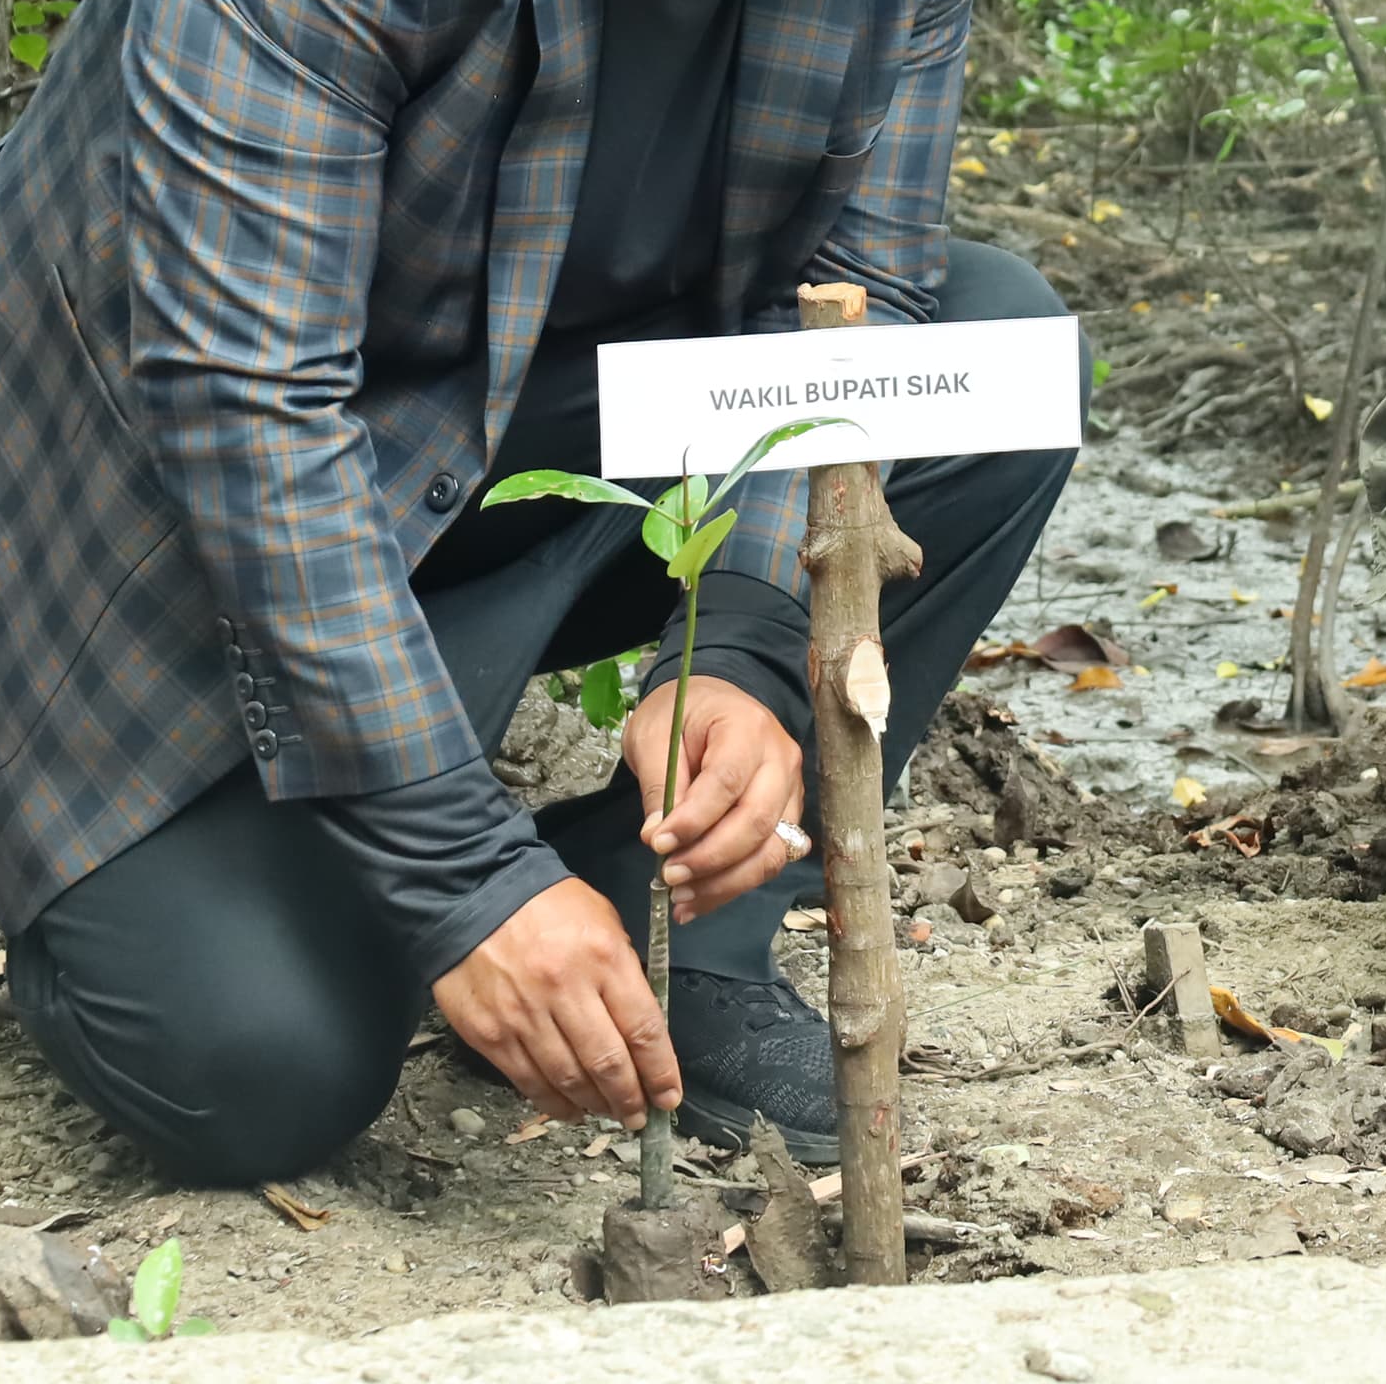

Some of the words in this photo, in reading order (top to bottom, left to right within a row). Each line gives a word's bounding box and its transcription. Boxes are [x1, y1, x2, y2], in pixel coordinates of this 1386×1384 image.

[709, 384, 798, 411] WAKIL
[805, 376, 899, 404] BUPATI
[907, 372, 972, 396] SIAK
